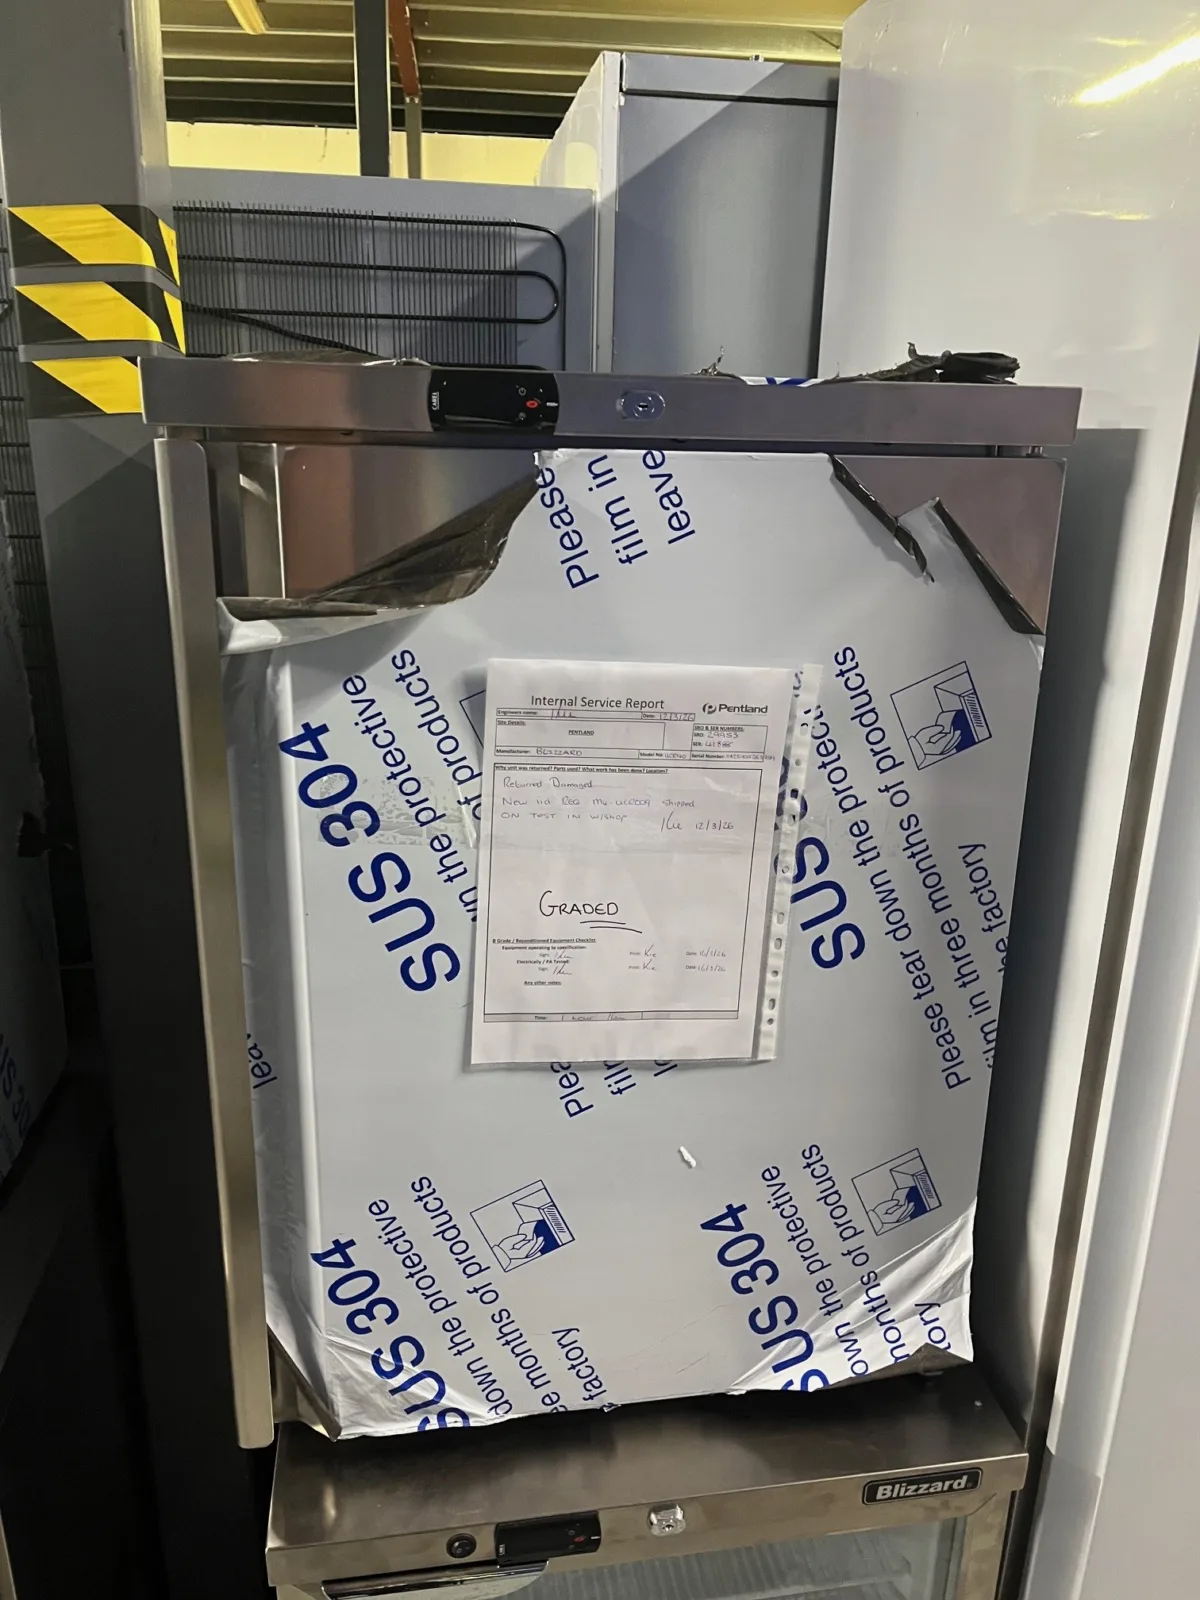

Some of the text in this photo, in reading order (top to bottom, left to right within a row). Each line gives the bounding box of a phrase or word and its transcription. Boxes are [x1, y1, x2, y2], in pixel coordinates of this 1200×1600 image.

[538, 467, 600, 588] Please
[587, 454, 648, 565] film in
[642, 450, 696, 545] leave
[391, 649, 483, 786] products
[531, 695, 665, 710] Internal Service Report
[718, 703, 768, 714] Pentland
[833, 646, 905, 774] products
[342, 674, 468, 884] the protective
[502, 797, 528, 806] New
[503, 776, 593, 789] Returned Damaged
[695, 819, 734, 831] 12/3/26
[877, 782, 911, 808] of
[278, 721, 461, 992] SUS 304
[539, 890, 619, 917] GRADED
[788, 837, 866, 969] SUS
[800, 704, 971, 1091] Please tear down the protec
[899, 813, 953, 915] months
[958, 842, 1007, 937] factory
[940, 917, 981, 989] three
[968, 990, 993, 1019] in
[247, 1034, 278, 1089] lea
[550, 1061, 594, 1118] Plea
[801, 1144, 865, 1242] products
[311, 1237, 400, 1336] 304
[410, 1175, 551, 1389] months of products
[700, 1203, 780, 1295] 304
[761, 1165, 869, 1377] own the protective
[841, 1244, 869, 1267] of
[368, 1199, 513, 1417] down the protective
[552, 1327, 607, 1401] factory
[876, 1475, 968, 1500] Blizzard
